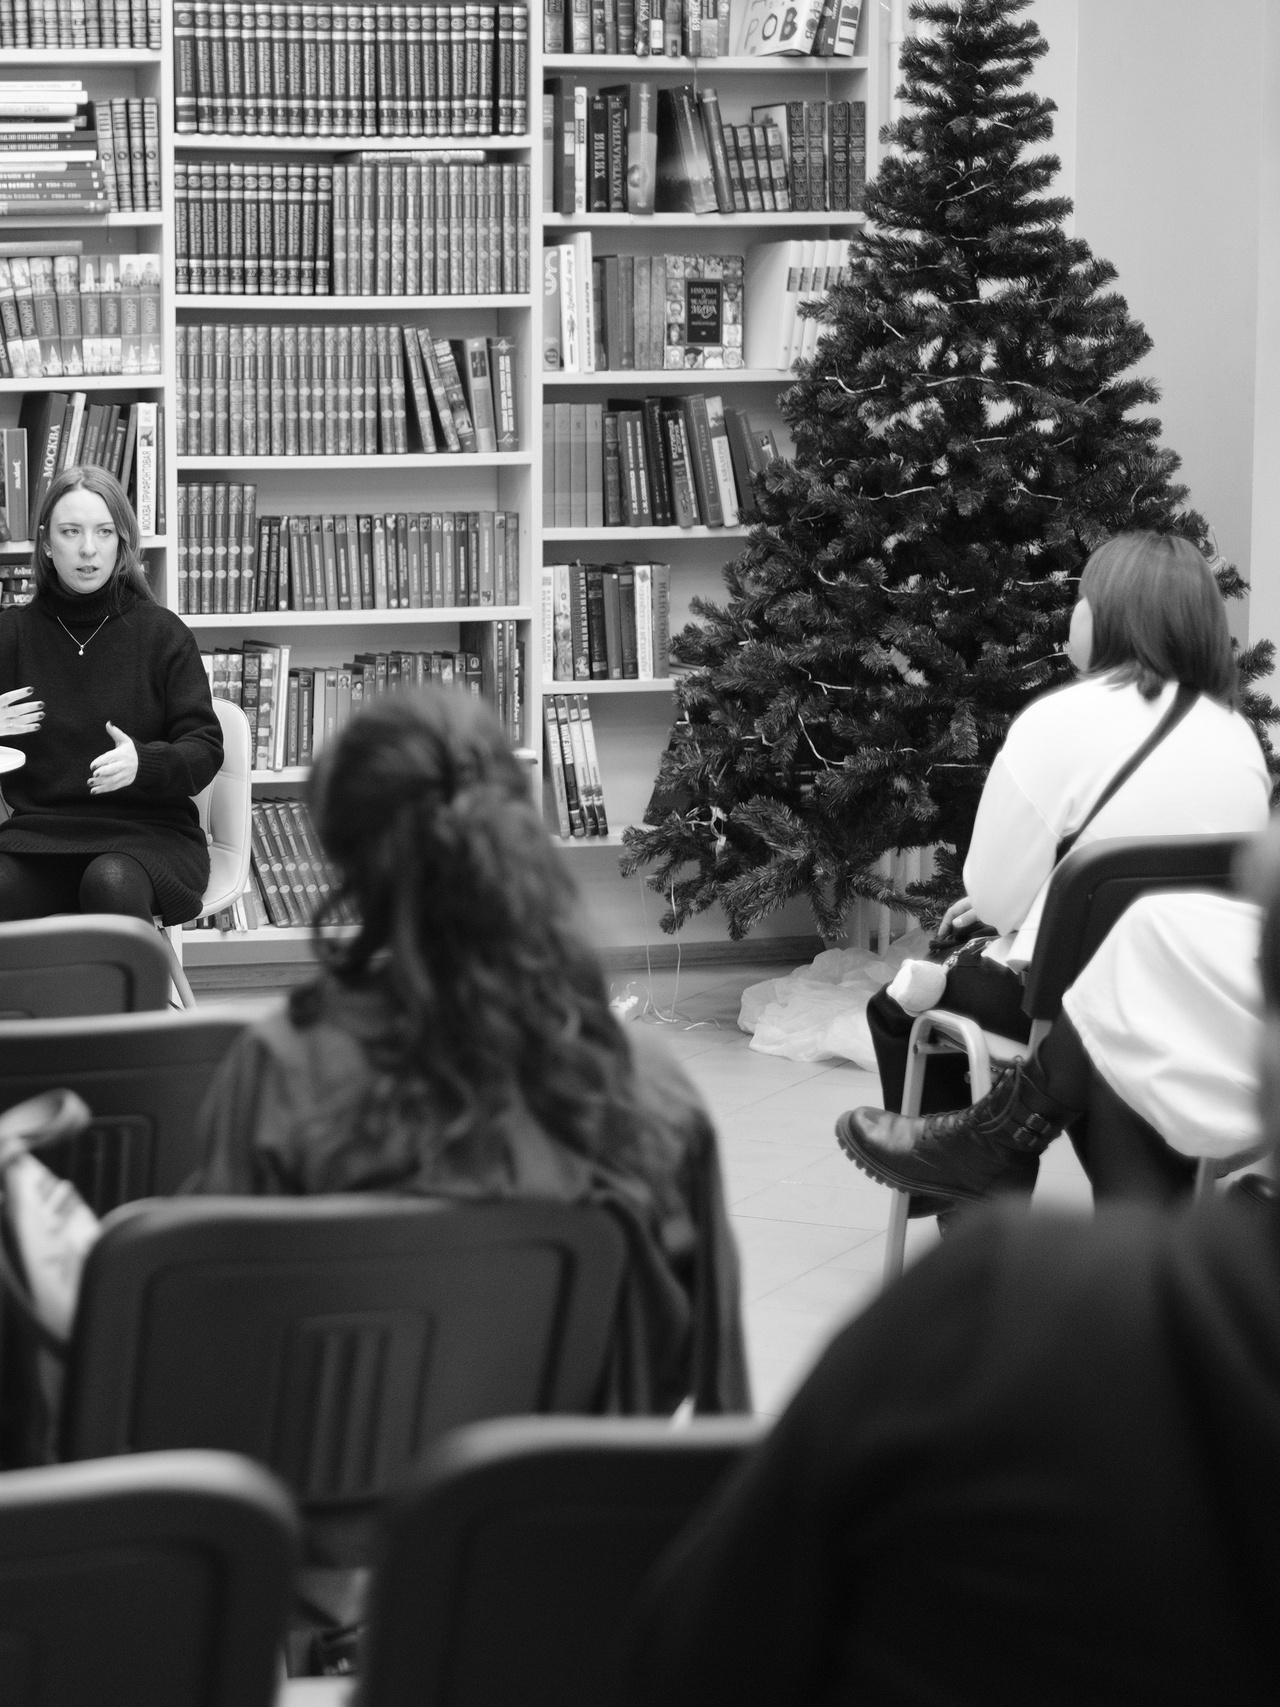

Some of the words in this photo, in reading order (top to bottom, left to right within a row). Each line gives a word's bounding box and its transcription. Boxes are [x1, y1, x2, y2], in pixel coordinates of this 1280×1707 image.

[593, 132, 606, 179] ХИМИЯ
[612, 112, 622, 199] МАТЕМАТИКА
[177, 268, 188, 277] 21
[42, 424, 61, 478] МОСКВА
[142, 450, 152, 503] ПРИФРОНТОВАЯ
[142, 504, 152, 531] МОСКВА
[658, 582, 667, 661] МИФОЛОГИЯ
